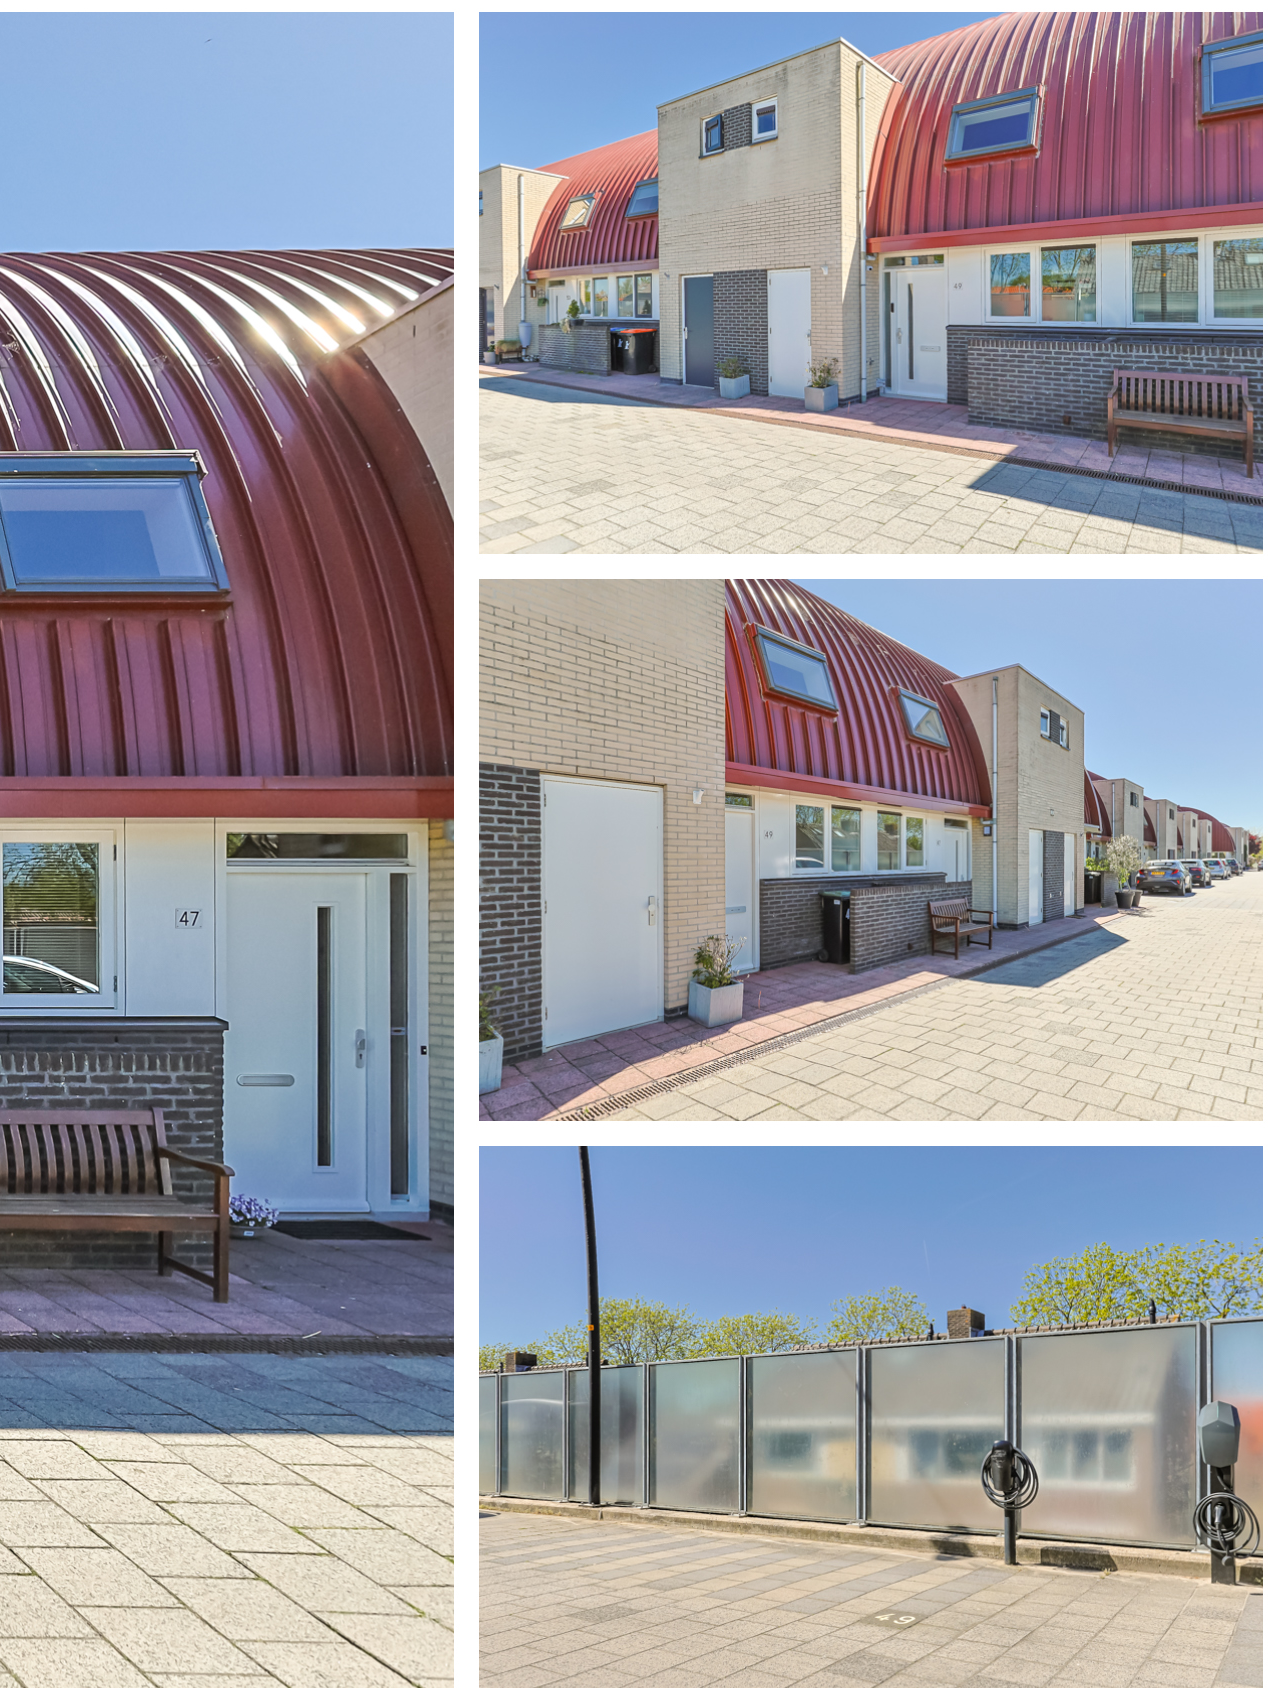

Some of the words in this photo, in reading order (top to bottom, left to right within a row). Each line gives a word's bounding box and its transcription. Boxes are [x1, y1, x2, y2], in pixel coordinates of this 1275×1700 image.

[764, 830, 773, 839] 49
[179, 911, 200, 927] 47
[874, 1613, 916, 1625] 49
